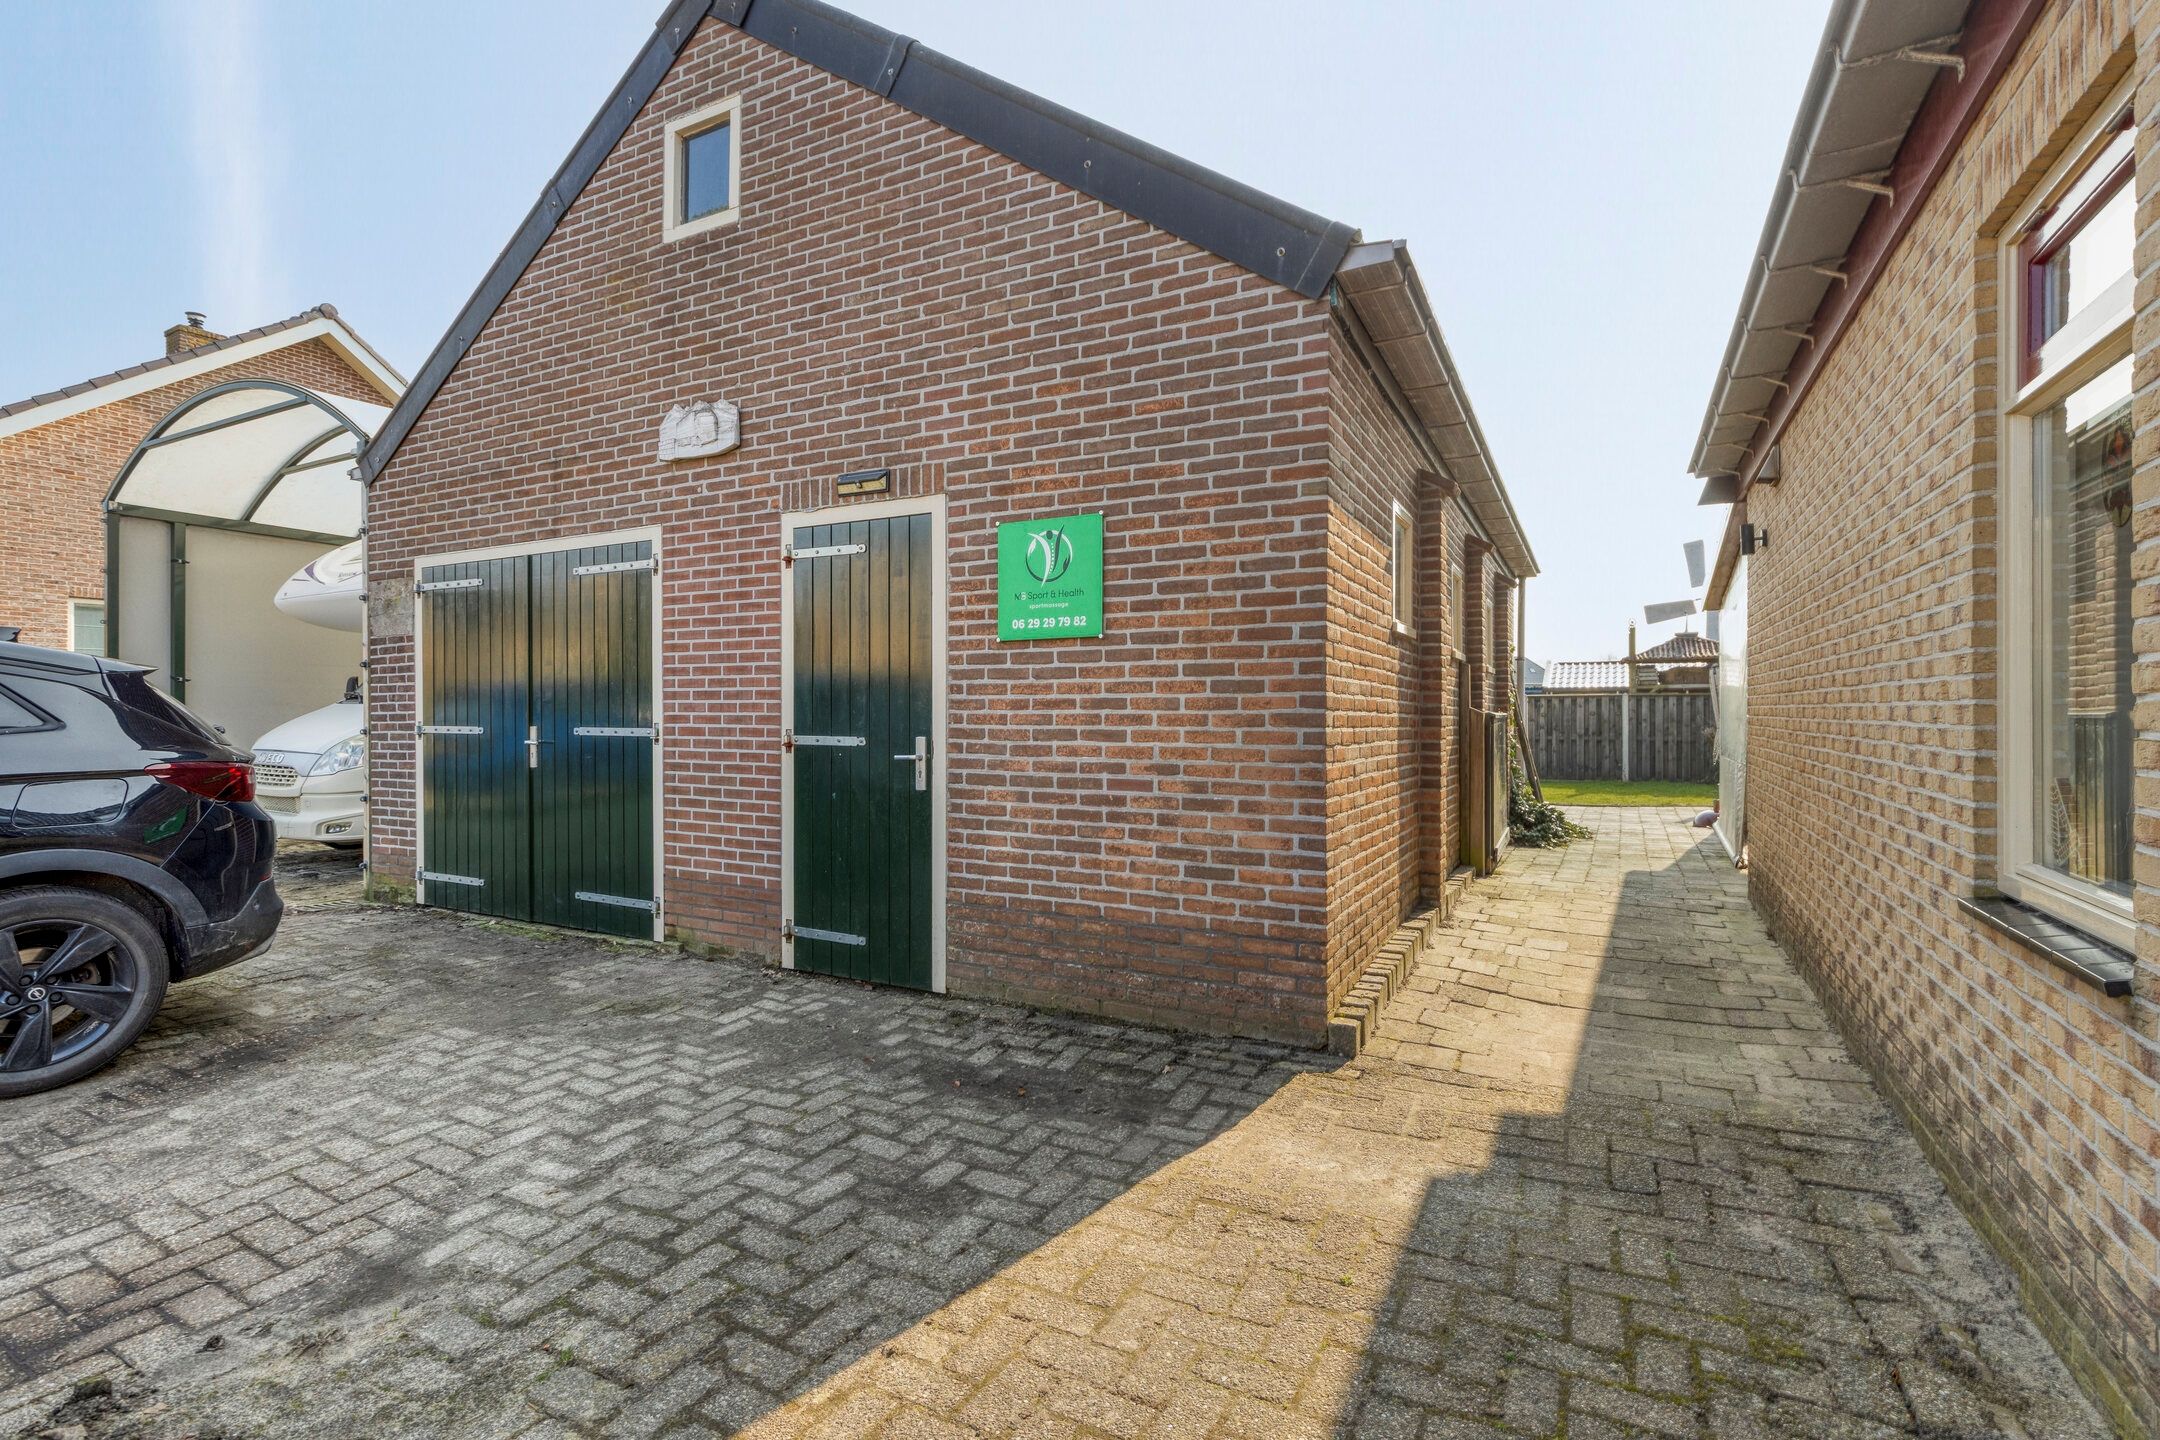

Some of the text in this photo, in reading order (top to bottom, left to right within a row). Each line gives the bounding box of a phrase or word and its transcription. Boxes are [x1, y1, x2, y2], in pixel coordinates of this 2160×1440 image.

[1027, 591, 1048, 601] Sport
[1058, 588, 1085, 598] Health
[1012, 615, 1087, 629] 06 29 29 79 82
